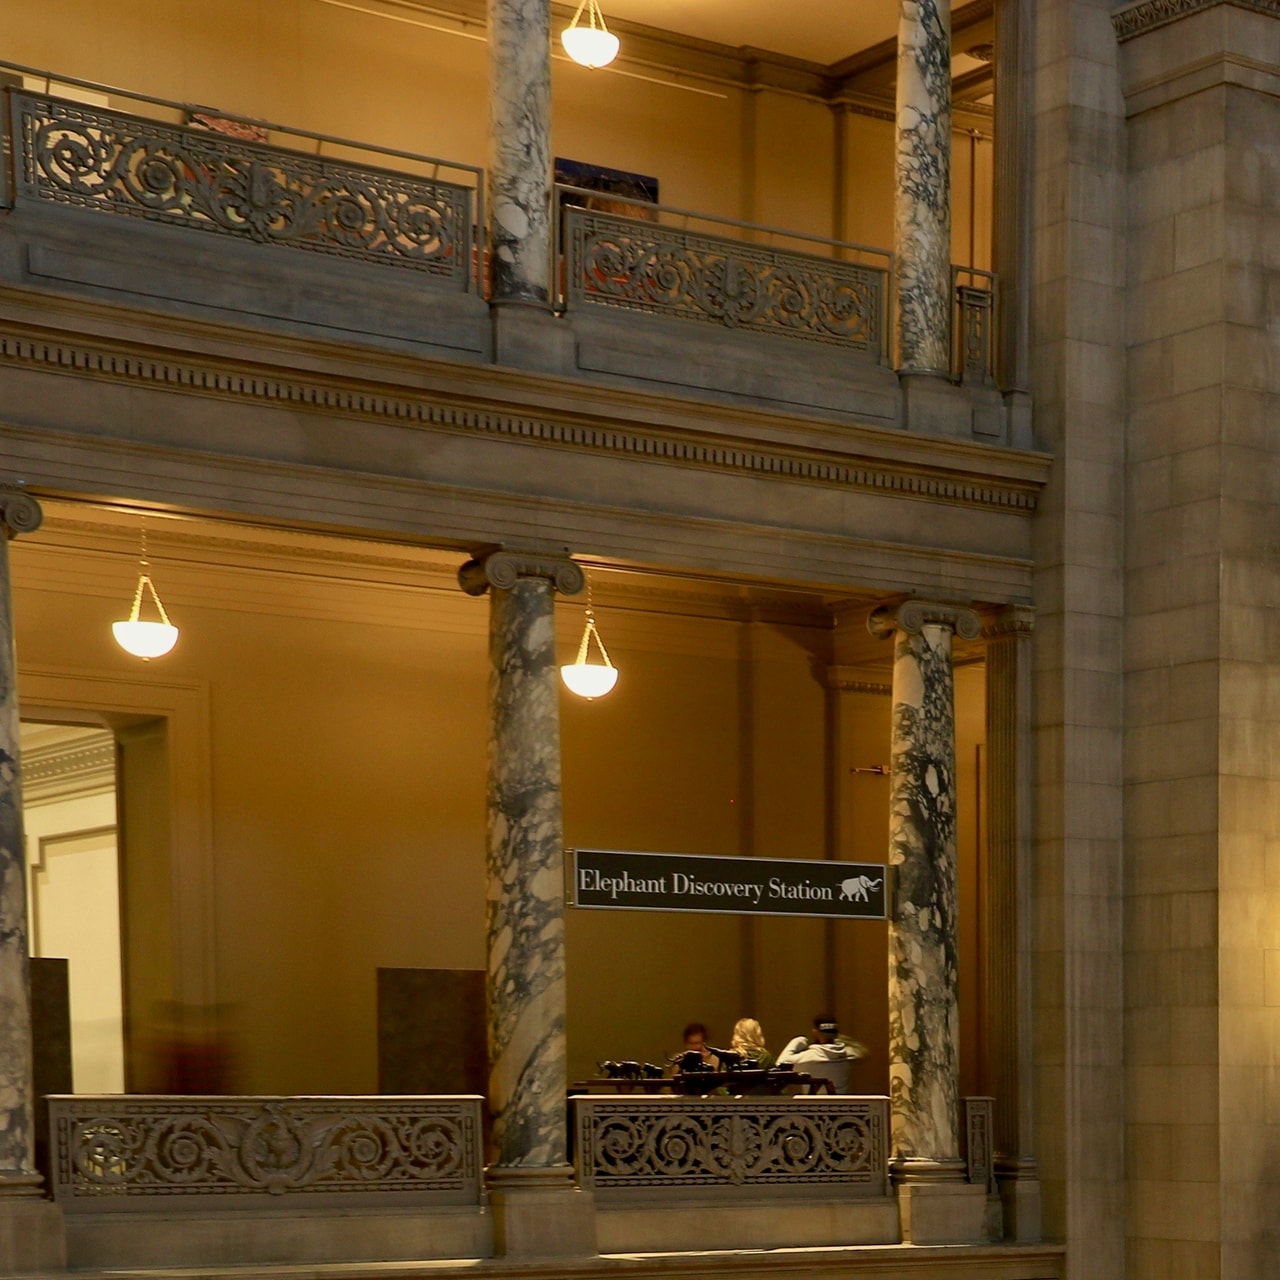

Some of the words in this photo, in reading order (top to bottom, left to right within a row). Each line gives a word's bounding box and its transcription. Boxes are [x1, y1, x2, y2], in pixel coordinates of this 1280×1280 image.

[578, 867, 668, 899] Elephant
[673, 872, 764, 904] Discovery
[768, 877, 833, 902] Station
